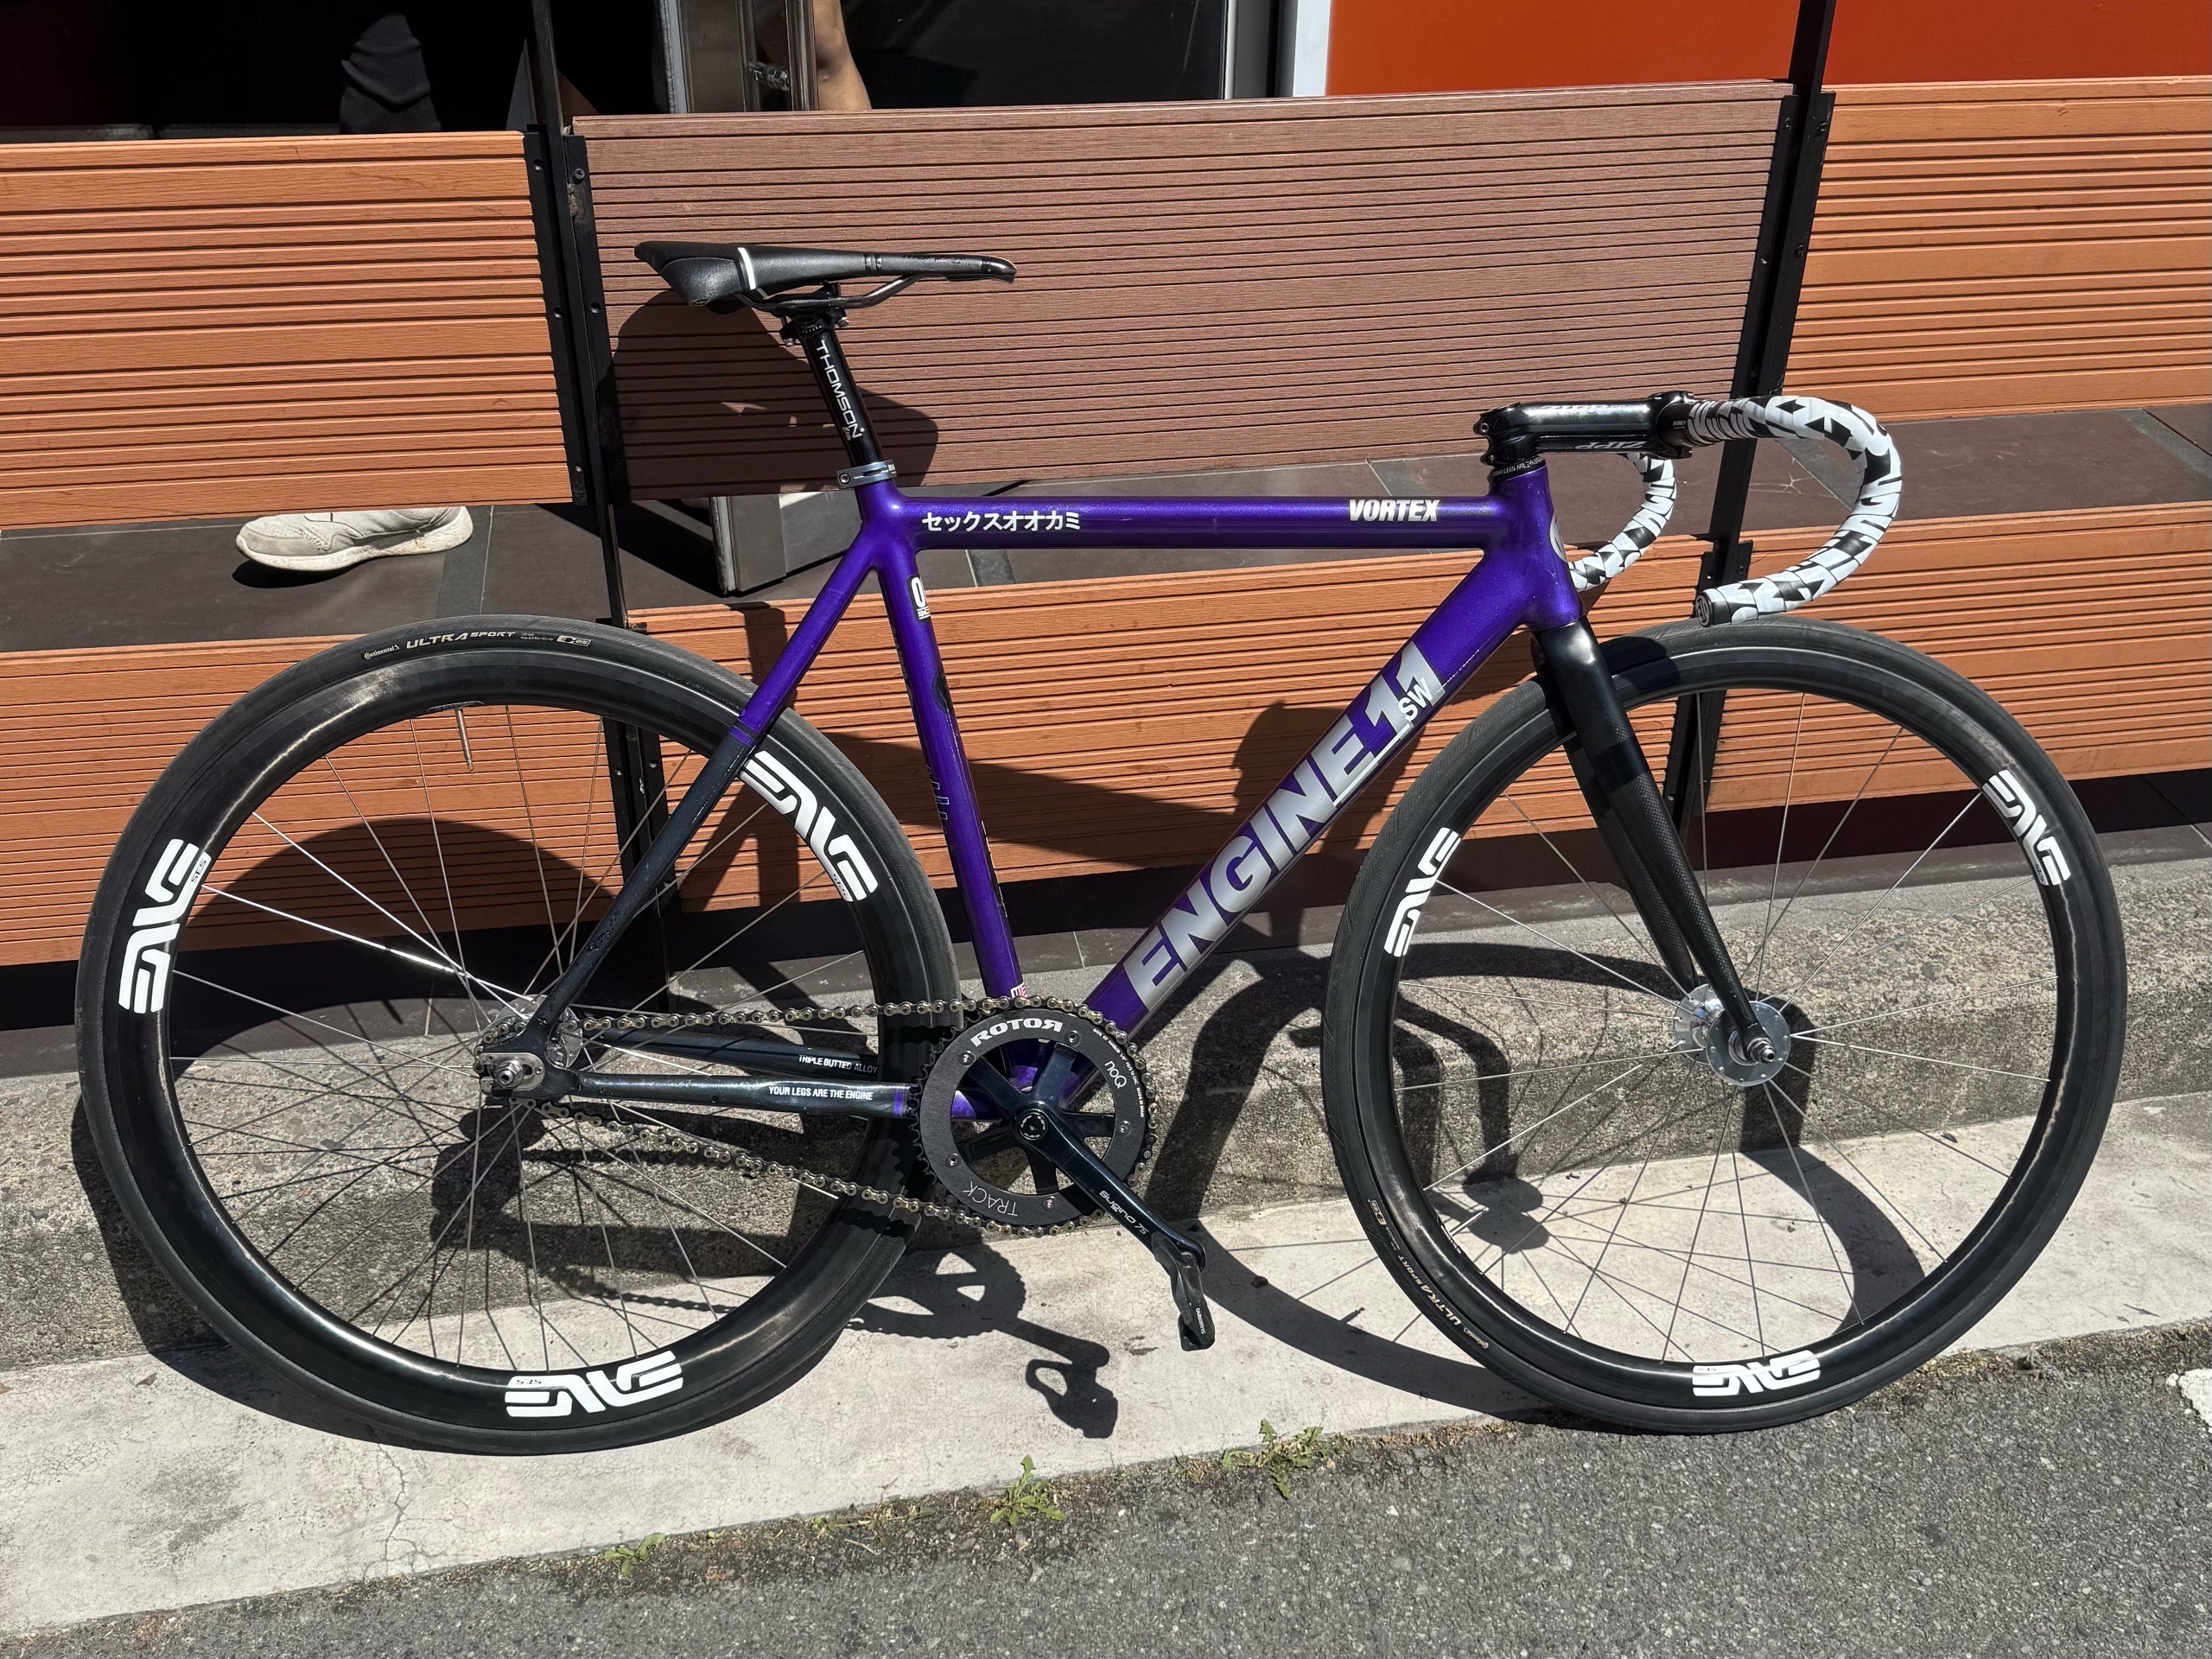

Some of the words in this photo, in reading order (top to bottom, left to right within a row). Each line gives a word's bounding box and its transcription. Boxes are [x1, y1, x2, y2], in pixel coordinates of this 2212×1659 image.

[815, 338, 865, 439] THOMSON
[921, 510, 1080, 531] セックスオオカミ
[1349, 499, 1440, 522] VORTEX
[406, 632, 468, 649] ULTRA
[1397, 677, 1435, 722] SW
[740, 750, 879, 902] ENVE
[1981, 769, 2071, 887] ENVE
[118, 838, 213, 1014] ENVE
[969, 1018, 1064, 1047] ROTOR
[798, 1053, 823, 1066] TRIPLE
[823, 1058, 852, 1071] BUTTED
[854, 1062, 879, 1074] ALLOY
[1104, 1060, 1127, 1090] noQ
[768, 1085, 791, 1096] YOUR
[791, 1087, 812, 1096] LEGS
[812, 1088, 829, 1097] ARE
[830, 1089, 845, 1099] THE
[845, 1090, 874, 1101] ENGINE
[963, 1180, 1019, 1217] TRACK
[1135, 1222, 1149, 1236] 75
[1398, 1255, 1423, 1286] SPORT
[1420, 1284, 1462, 1326] ULTRA
[505, 1350, 683, 1418] ENVE
